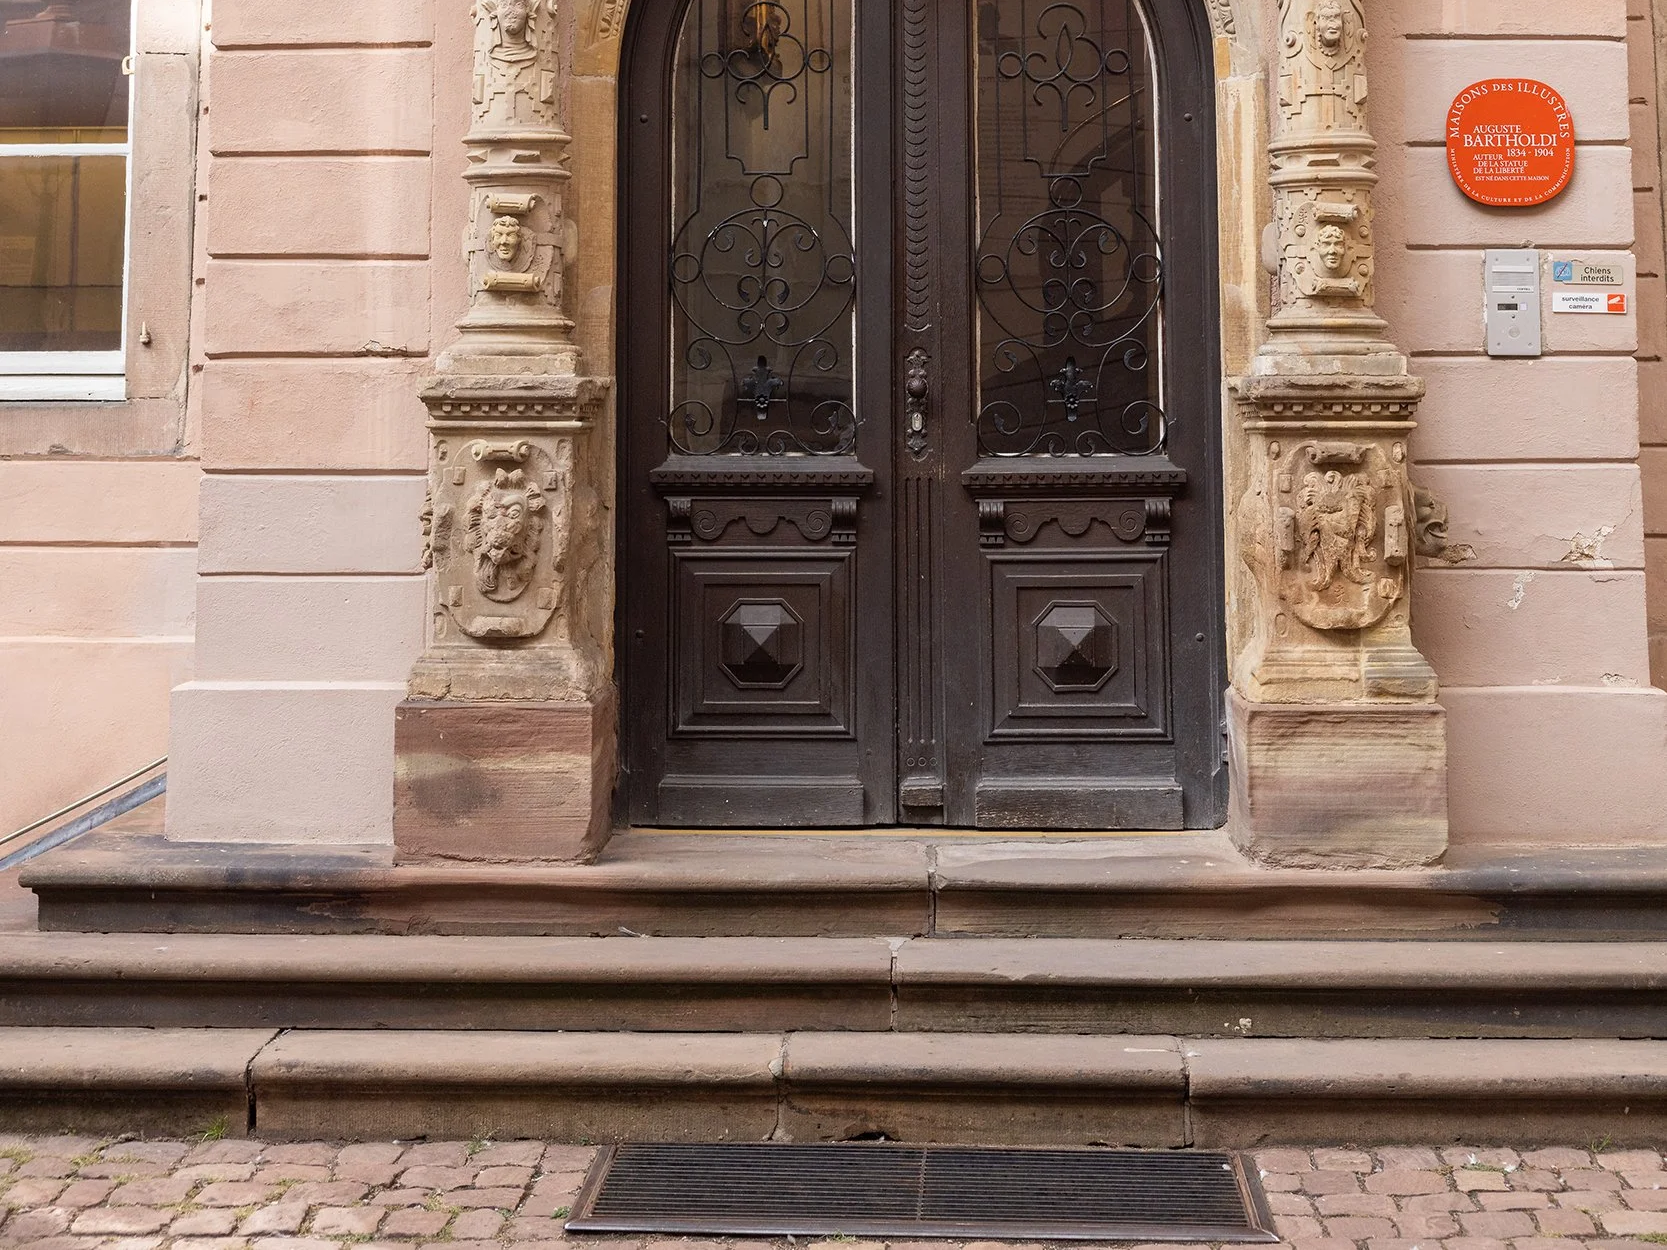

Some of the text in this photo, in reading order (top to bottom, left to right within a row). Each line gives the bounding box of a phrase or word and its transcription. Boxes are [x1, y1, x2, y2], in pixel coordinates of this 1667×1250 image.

[1449, 82, 1570, 138] MAISONS DES ILLUSTRES
[1473, 124, 1522, 134] AUGUSTE
[1463, 134, 1557, 147] BARTHOLDI
[1507, 148, 1526, 157] 1834
[1534, 148, 1554, 157] 1904
[1584, 266, 1611, 274] Chiens
[1580, 274, 1614, 282] interdits
